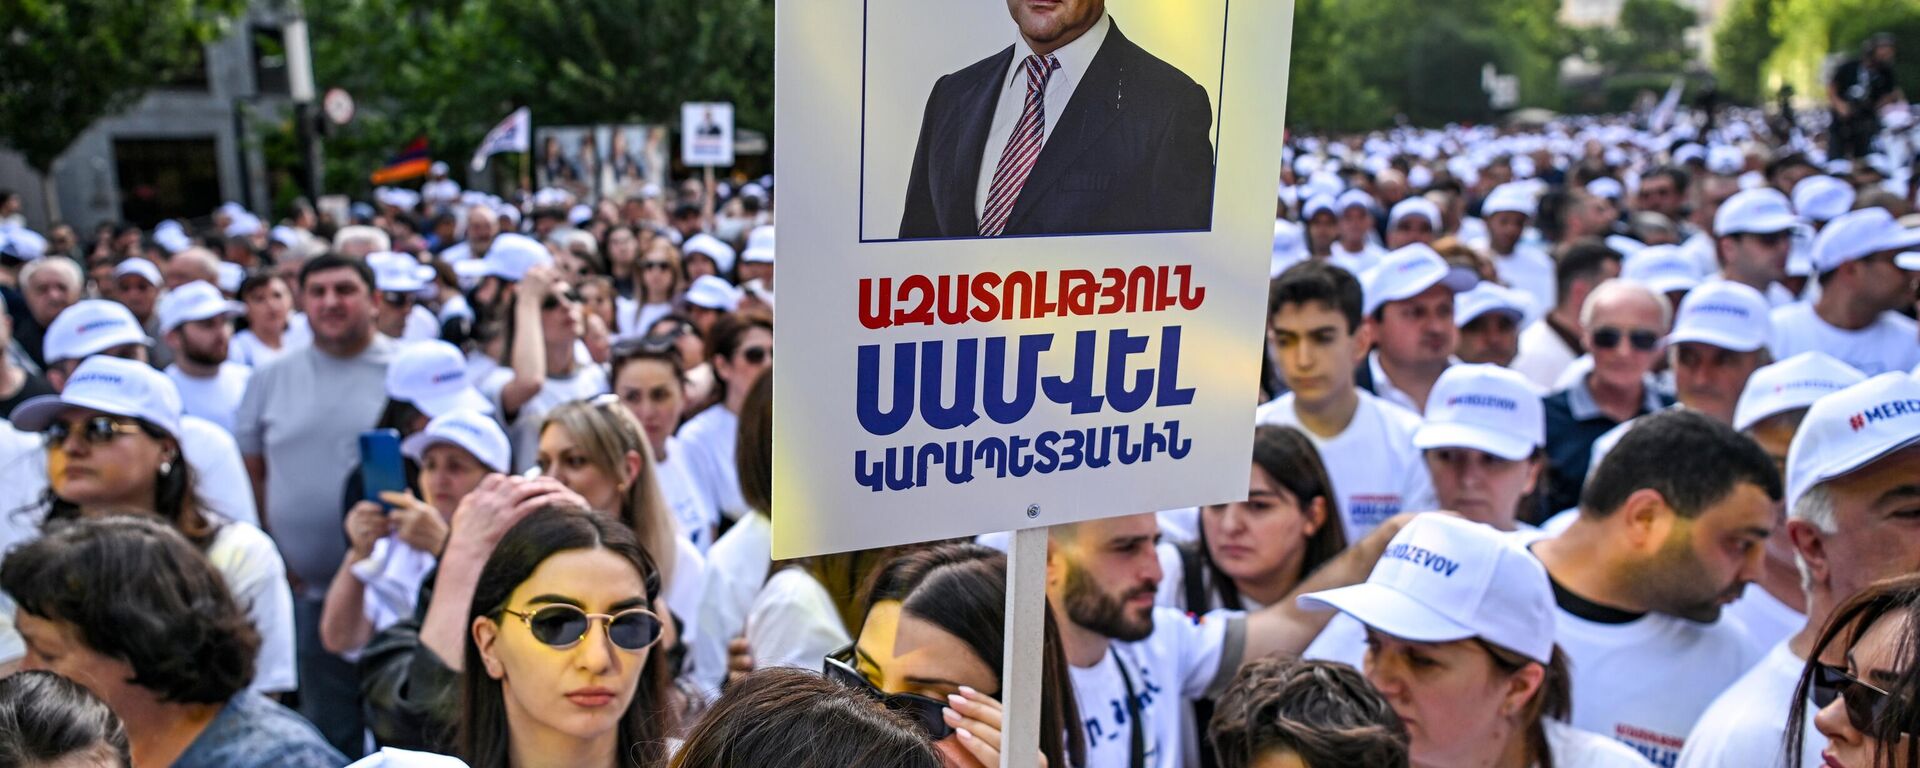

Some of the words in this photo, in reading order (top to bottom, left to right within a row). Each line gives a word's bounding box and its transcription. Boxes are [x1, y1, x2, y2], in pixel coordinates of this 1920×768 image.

[859, 265, 1205, 329] ԱԶԱՏՈՒԹՅՈՒՆ
[856, 326, 1196, 436] ՍԱՄՎԵԼ
[855, 421, 1192, 492] ԿԱՐԱՊԵՏՅԱՆԻՆ
